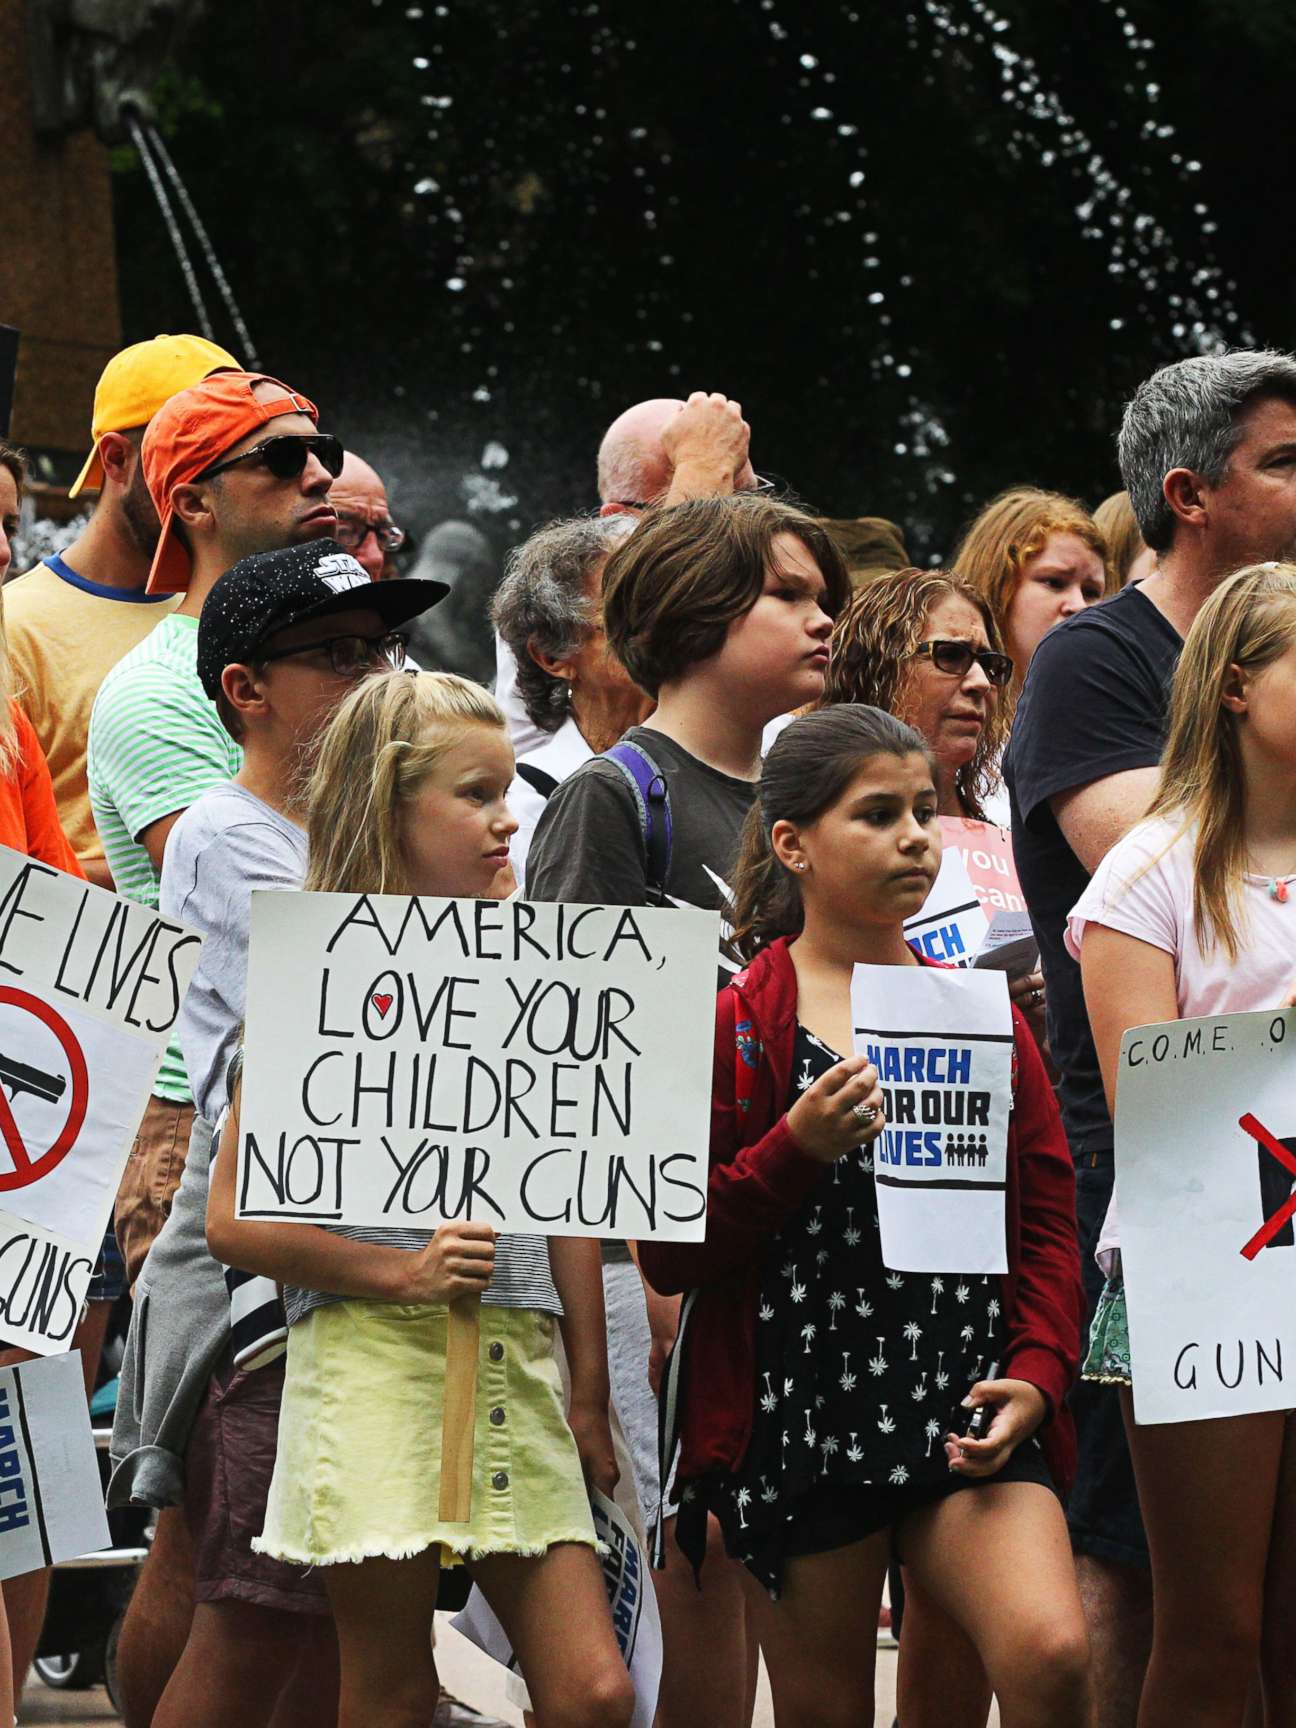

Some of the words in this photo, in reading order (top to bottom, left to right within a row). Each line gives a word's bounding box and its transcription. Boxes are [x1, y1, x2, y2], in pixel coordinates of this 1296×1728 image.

[54, 888, 202, 1033] LIVES
[326, 893, 666, 971] AMERICA,
[318, 968, 480, 1050] LOVE
[501, 977, 642, 1061] YOUR
[302, 1051, 632, 1139] CHILDREN
[921, 1090, 991, 1126] OUR
[240, 1132, 360, 1213] NOT
[380, 1137, 505, 1221] YOUR
[520, 1148, 705, 1231] GUNS
[1174, 1338, 1283, 1390] GUN
